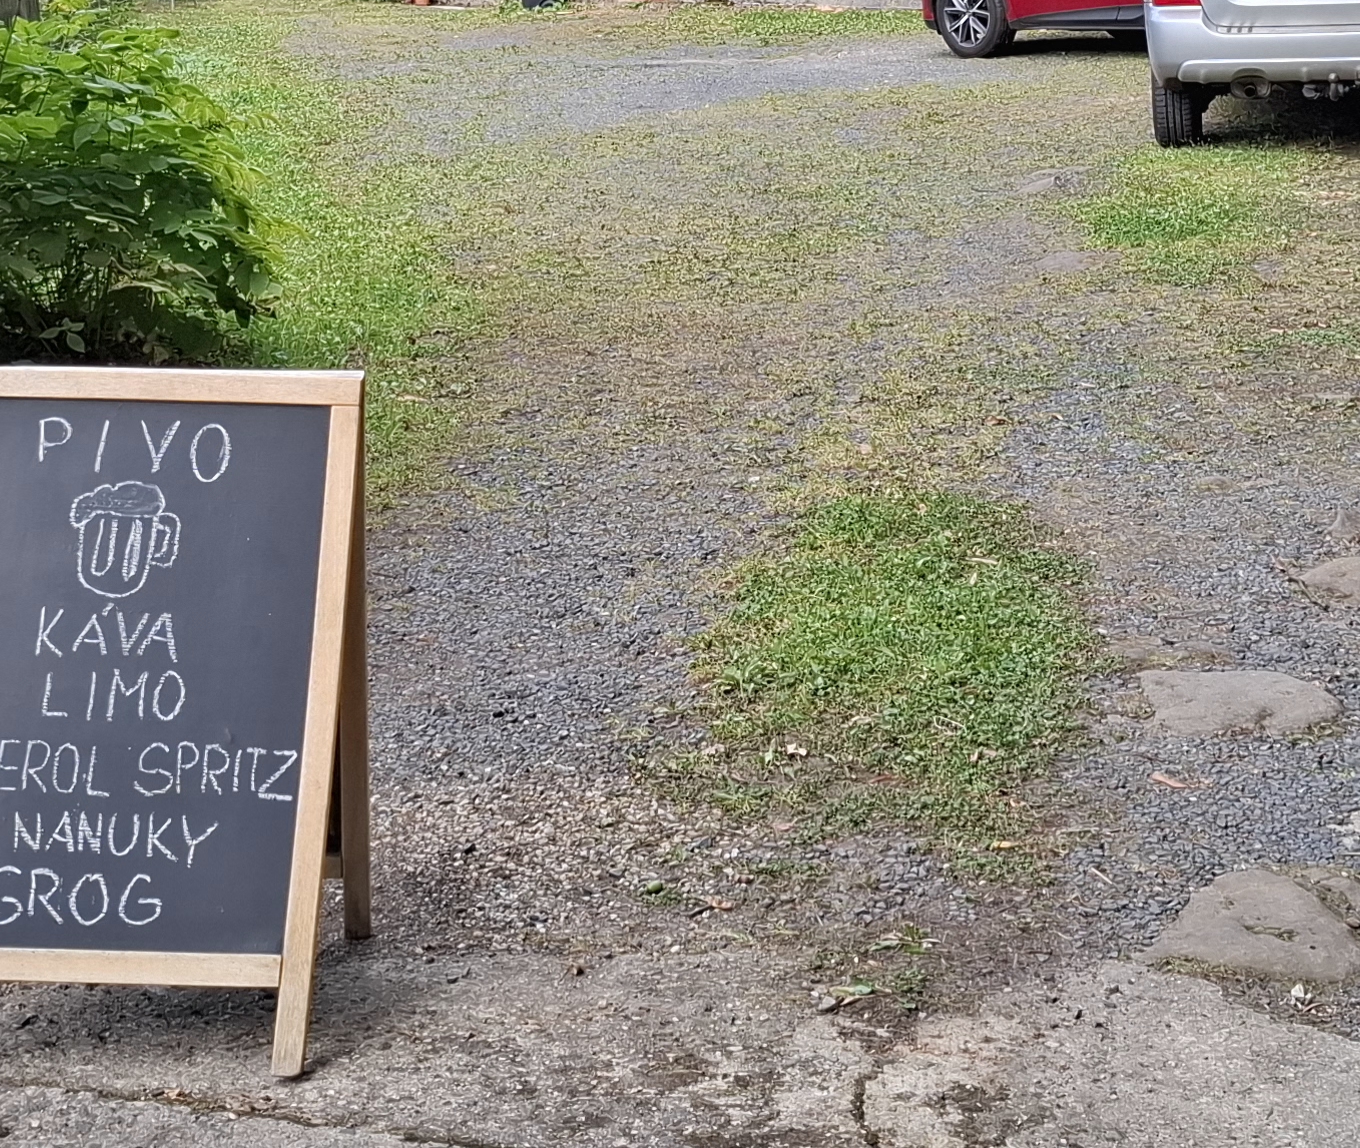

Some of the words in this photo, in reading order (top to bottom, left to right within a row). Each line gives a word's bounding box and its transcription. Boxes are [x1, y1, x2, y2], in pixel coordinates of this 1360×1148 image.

[37, 415, 233, 483] PIVO
[35, 602, 179, 664] KÁVA
[41, 668, 187, 723] LIMO
[133, 741, 299, 802] SPRITZ
[12, 810, 219, 869] NANUKY
